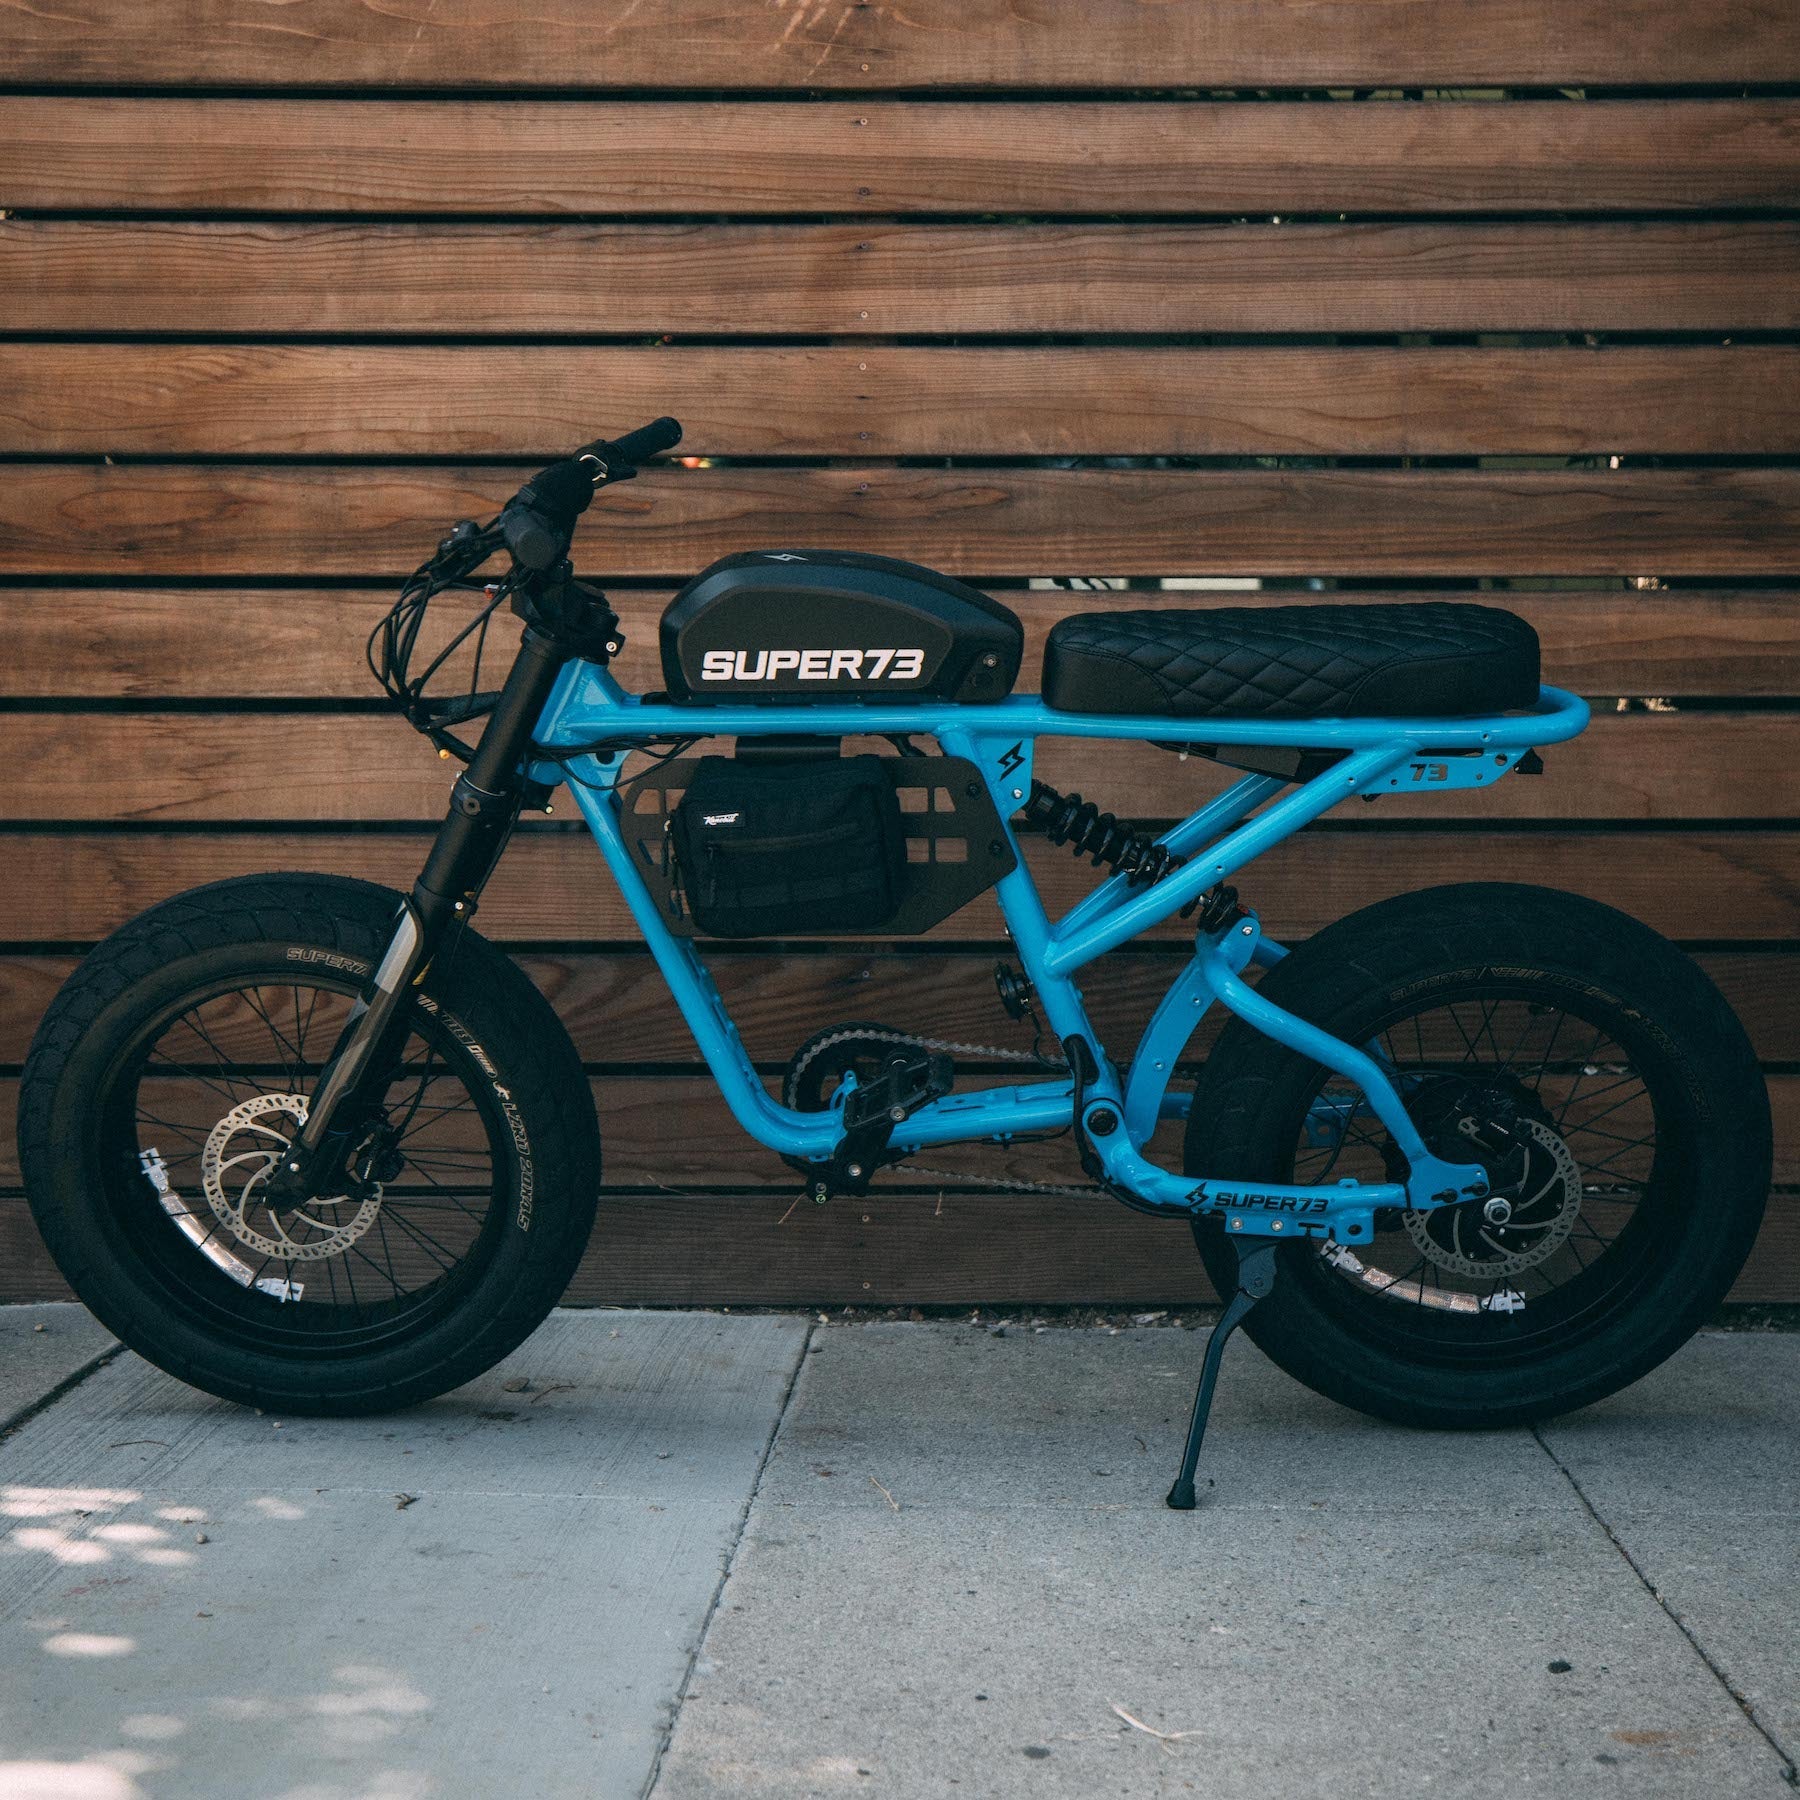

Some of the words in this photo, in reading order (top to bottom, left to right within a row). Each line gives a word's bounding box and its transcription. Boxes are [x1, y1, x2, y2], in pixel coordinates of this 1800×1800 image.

[701, 649, 925, 681] SUPER73
[1409, 763, 1449, 782] 73
[286, 947, 371, 977] SUPER7
[1214, 1192, 1329, 1212] SUPER73
